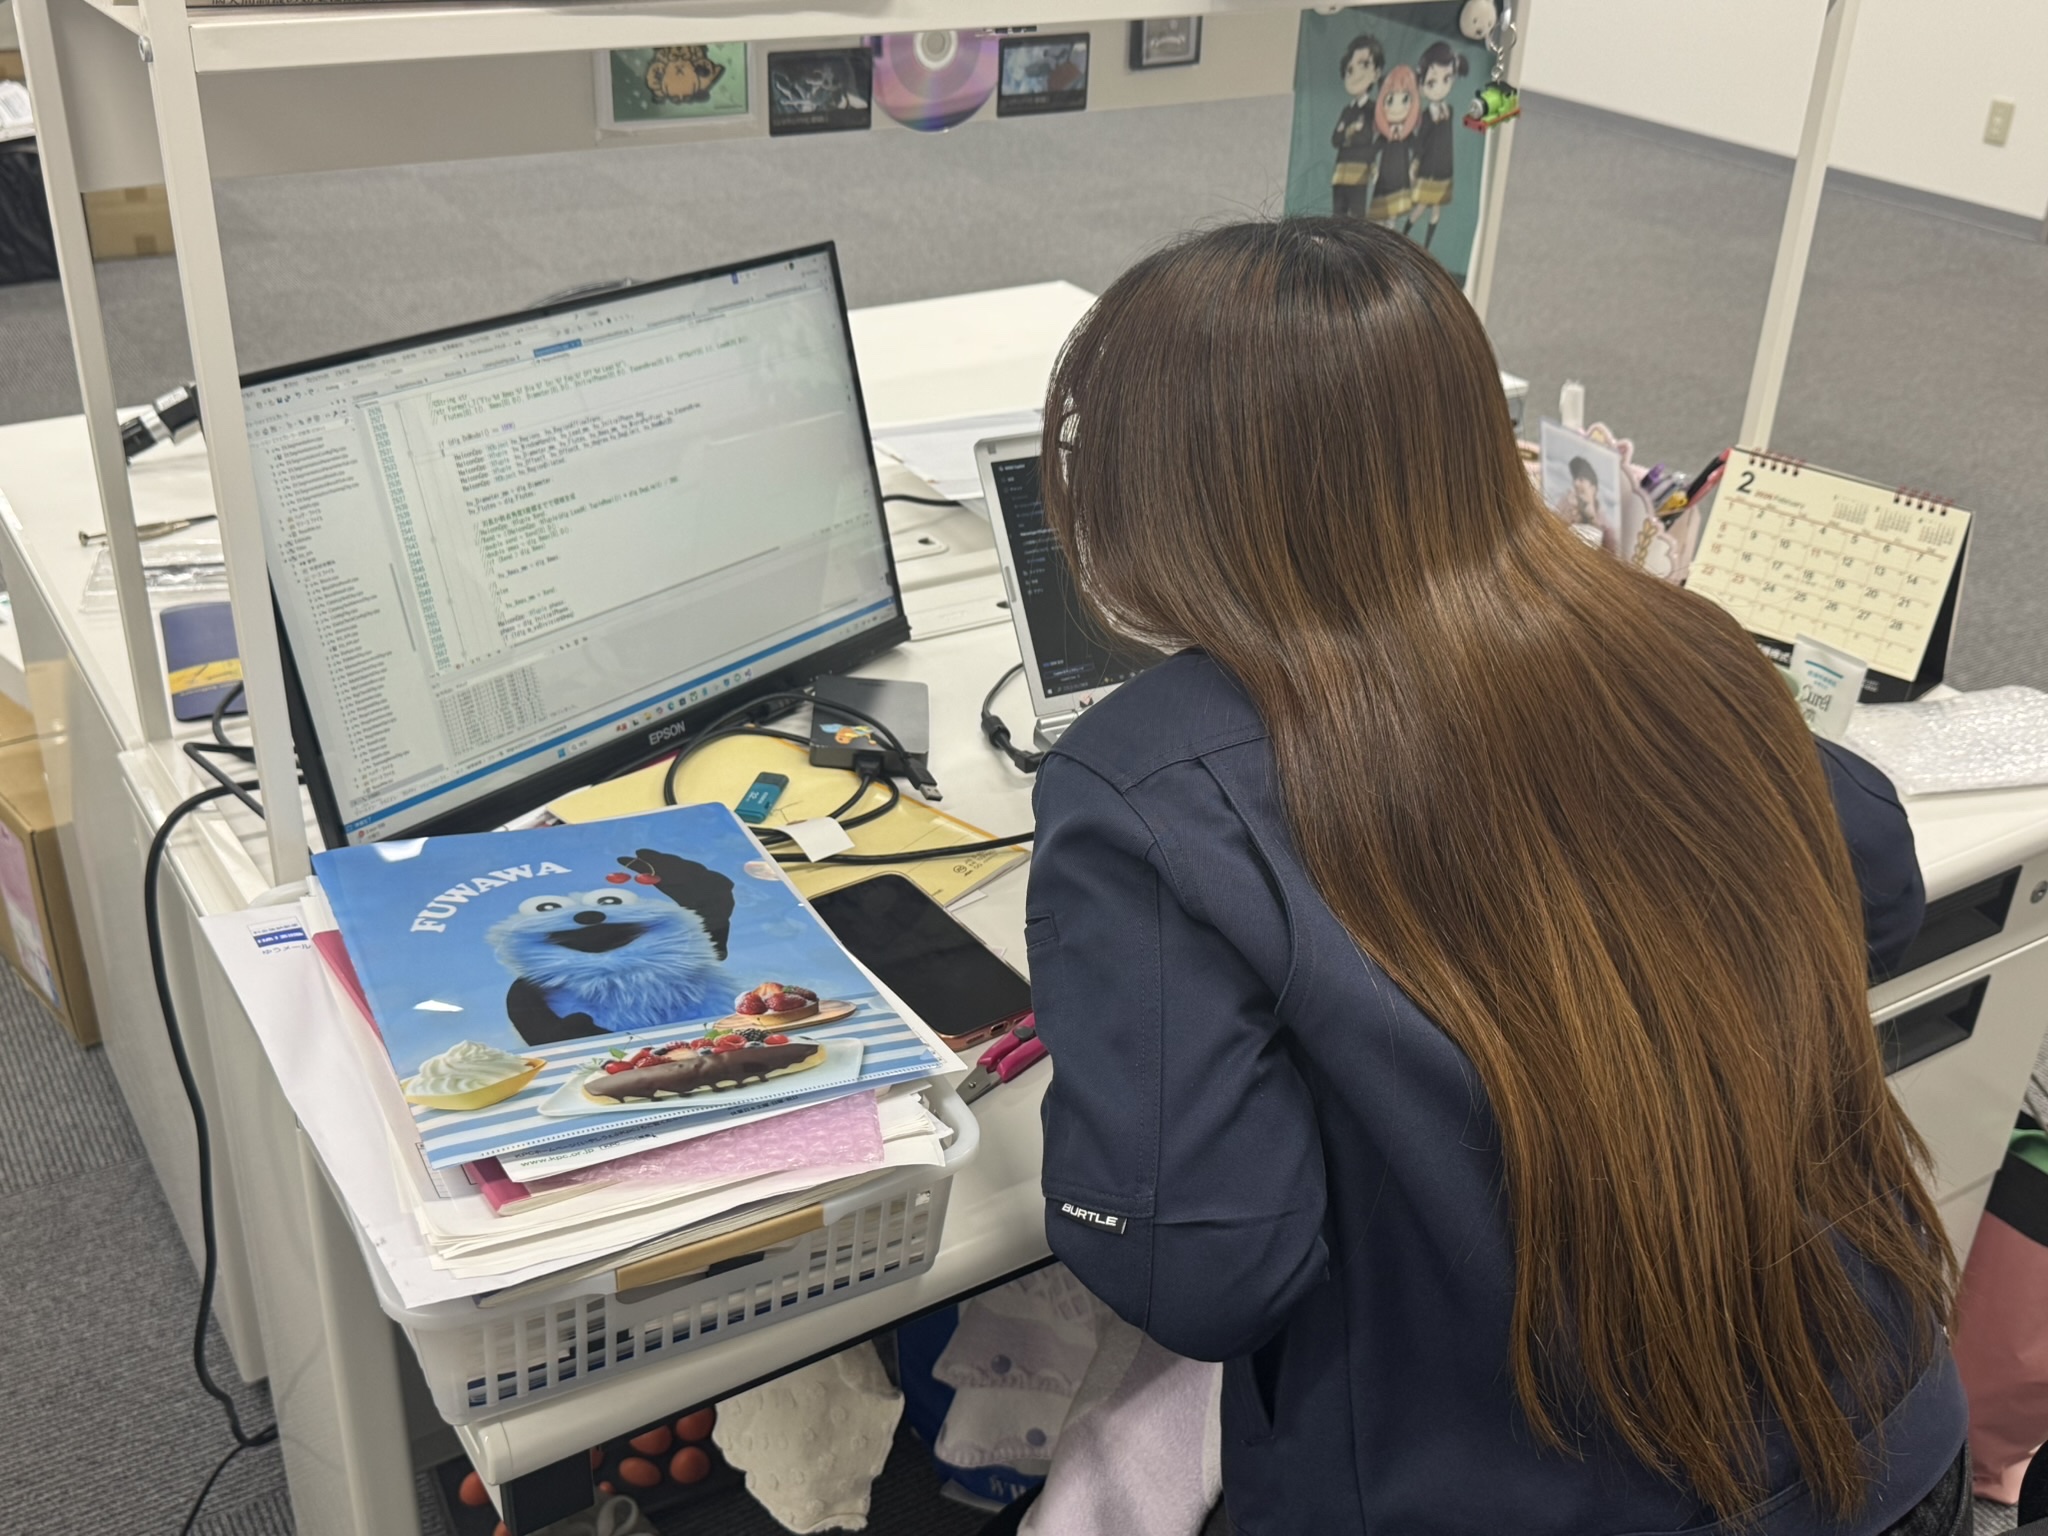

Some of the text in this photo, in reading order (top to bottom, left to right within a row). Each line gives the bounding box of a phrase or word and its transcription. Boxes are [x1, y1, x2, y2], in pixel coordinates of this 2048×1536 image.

[1736, 471, 1755, 494] 2
[649, 720, 685, 745] EPSON
[410, 861, 572, 933] FUWAWA
[520, 1148, 594, 1167] www.kpc.or.jp
[1061, 1203, 1118, 1227] BURTLE
